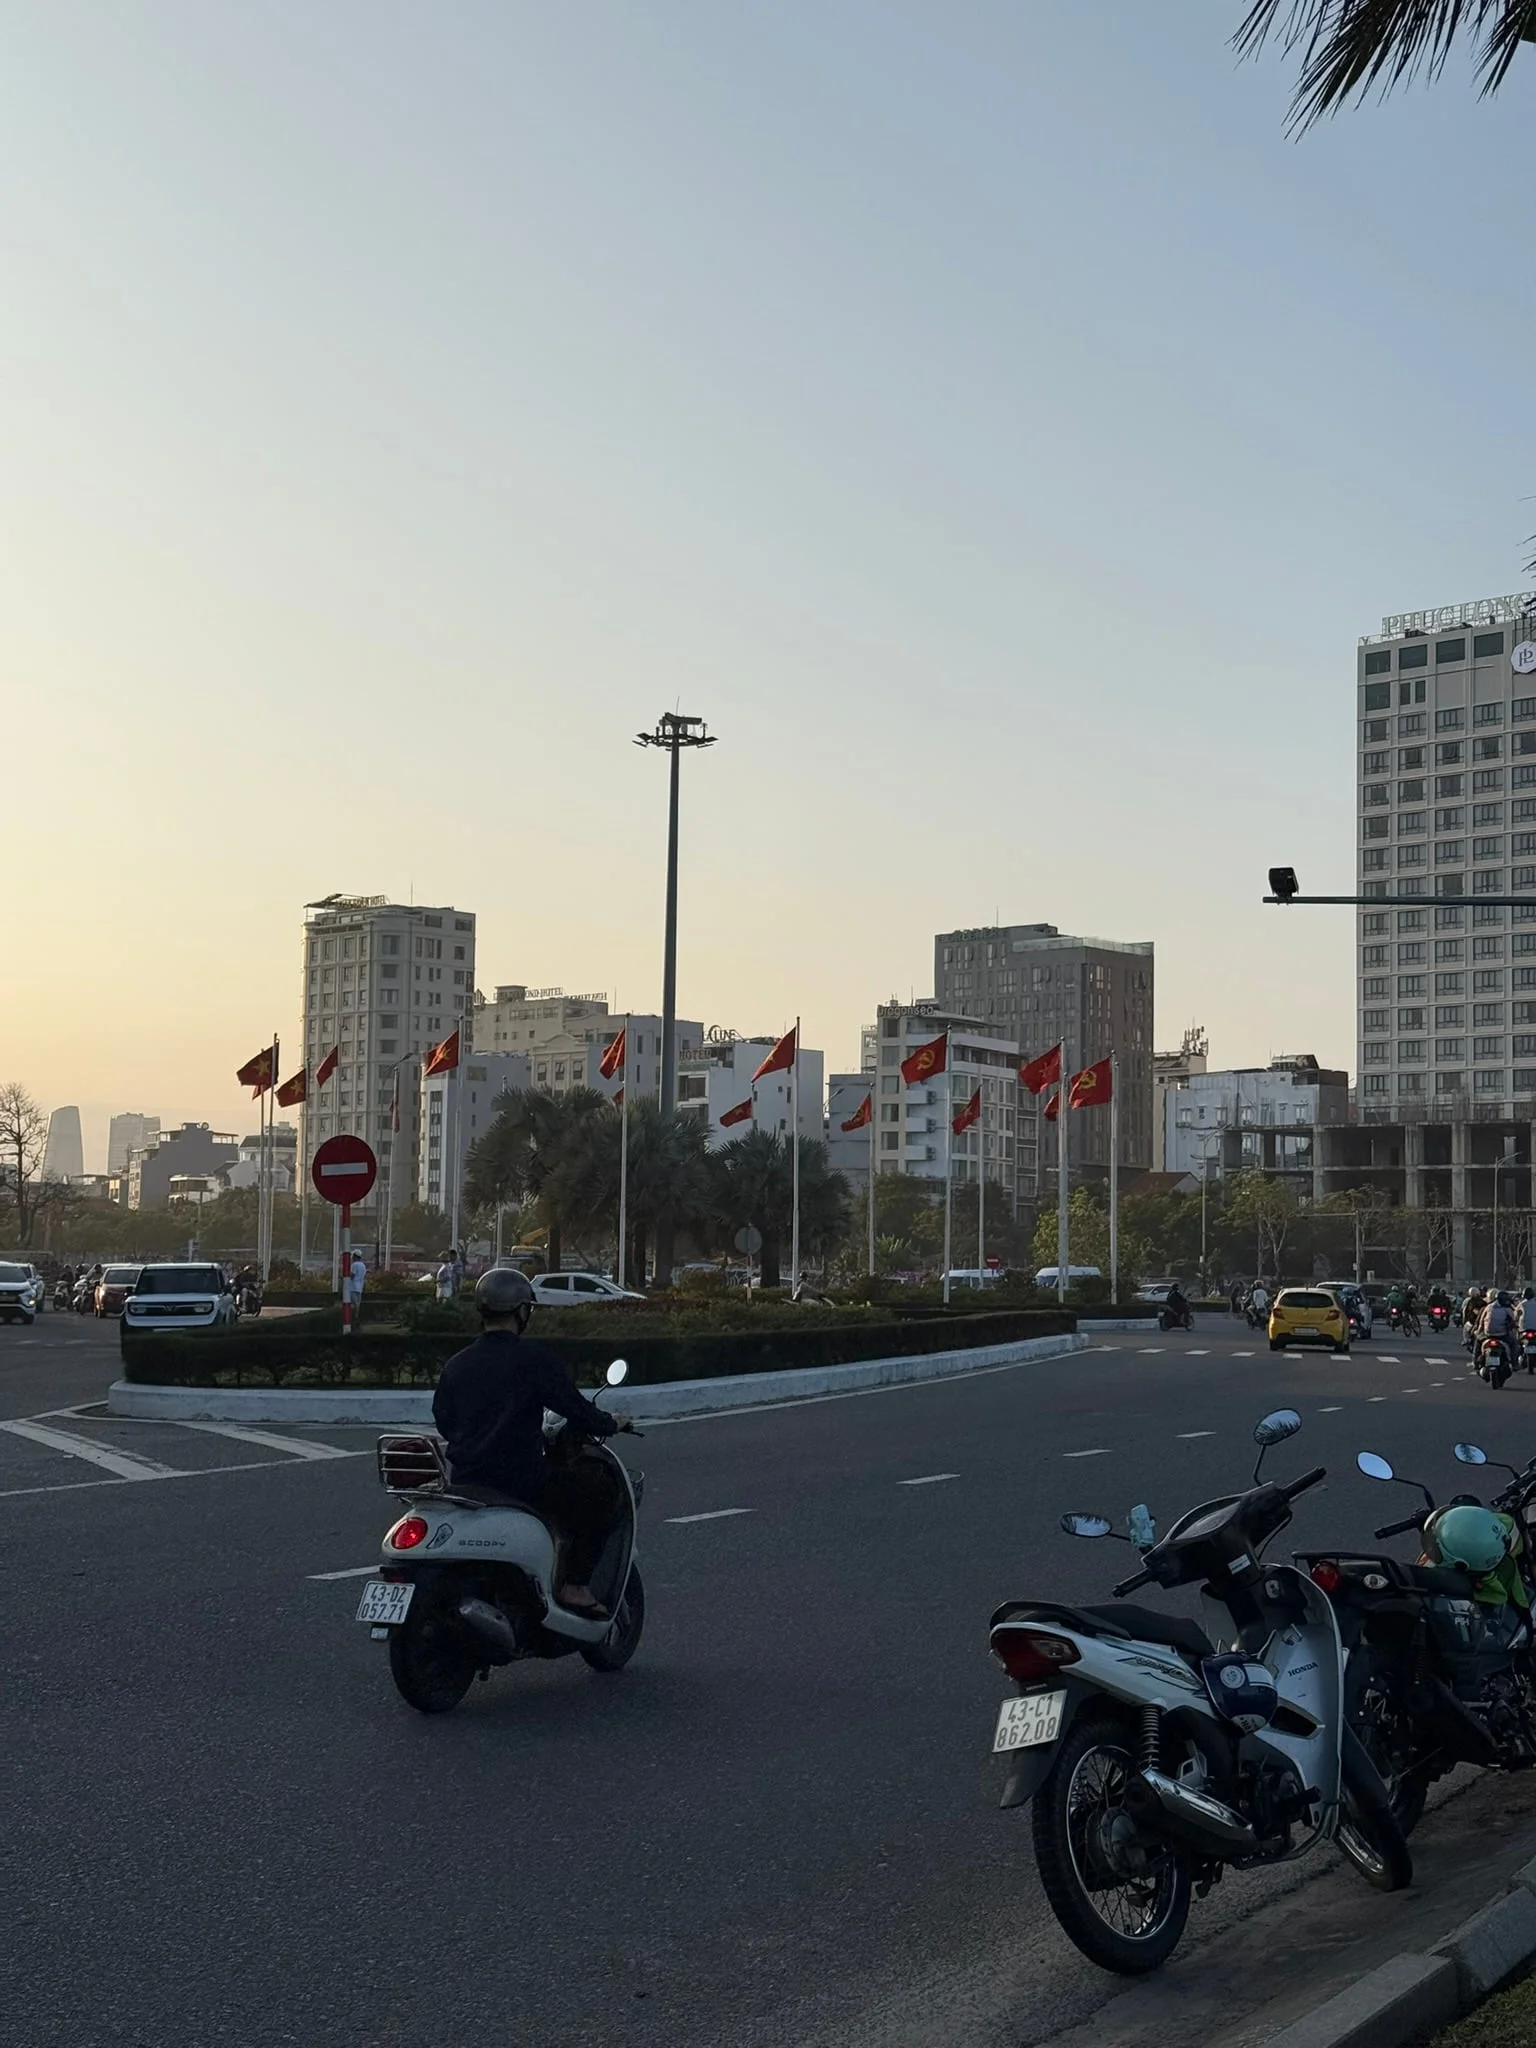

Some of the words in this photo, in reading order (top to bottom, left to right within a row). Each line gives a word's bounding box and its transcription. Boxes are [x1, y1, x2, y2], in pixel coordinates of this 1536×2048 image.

[370, 1585, 408, 1603] 43-D2
[361, 1603, 406, 1620] 057.71
[1287, 1662, 1319, 1677] HONDA
[1007, 1694, 1054, 1723] 43-C1
[996, 1716, 1057, 1748] 862.08
